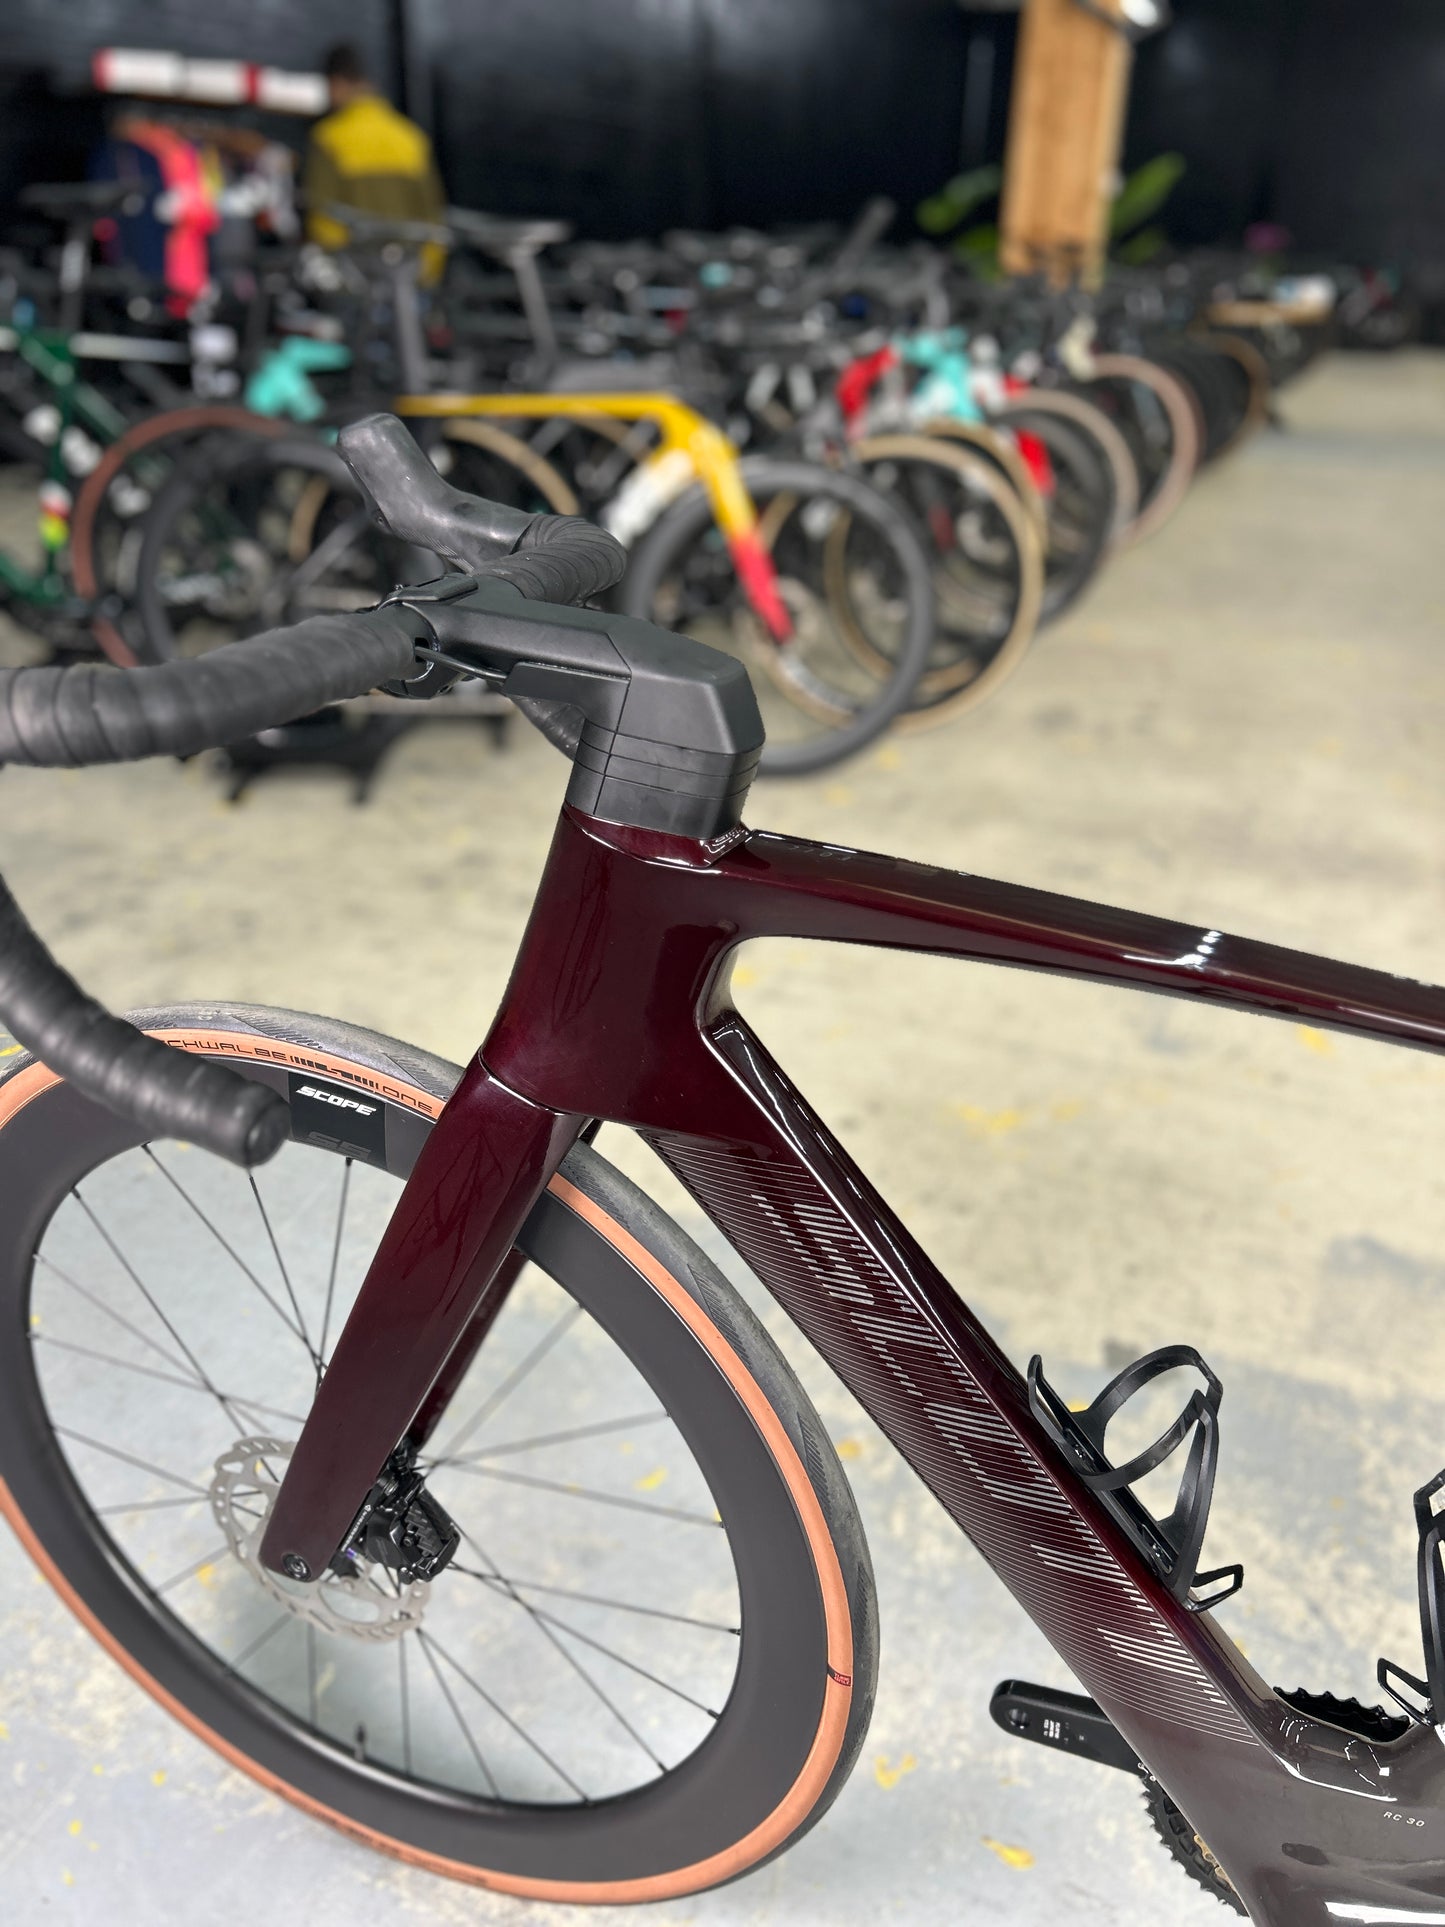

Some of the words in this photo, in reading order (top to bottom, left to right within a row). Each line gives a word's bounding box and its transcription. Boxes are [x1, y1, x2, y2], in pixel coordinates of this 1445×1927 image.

[162, 1039, 288, 1061] CHWALBE
[382, 1085, 433, 1114] ONE
[295, 1085, 377, 1116] SCOPE
[750, 1194, 1229, 1706] SCOTT
[1383, 1811, 1403, 1821] RC
[1406, 1817, 1425, 1827] 30
